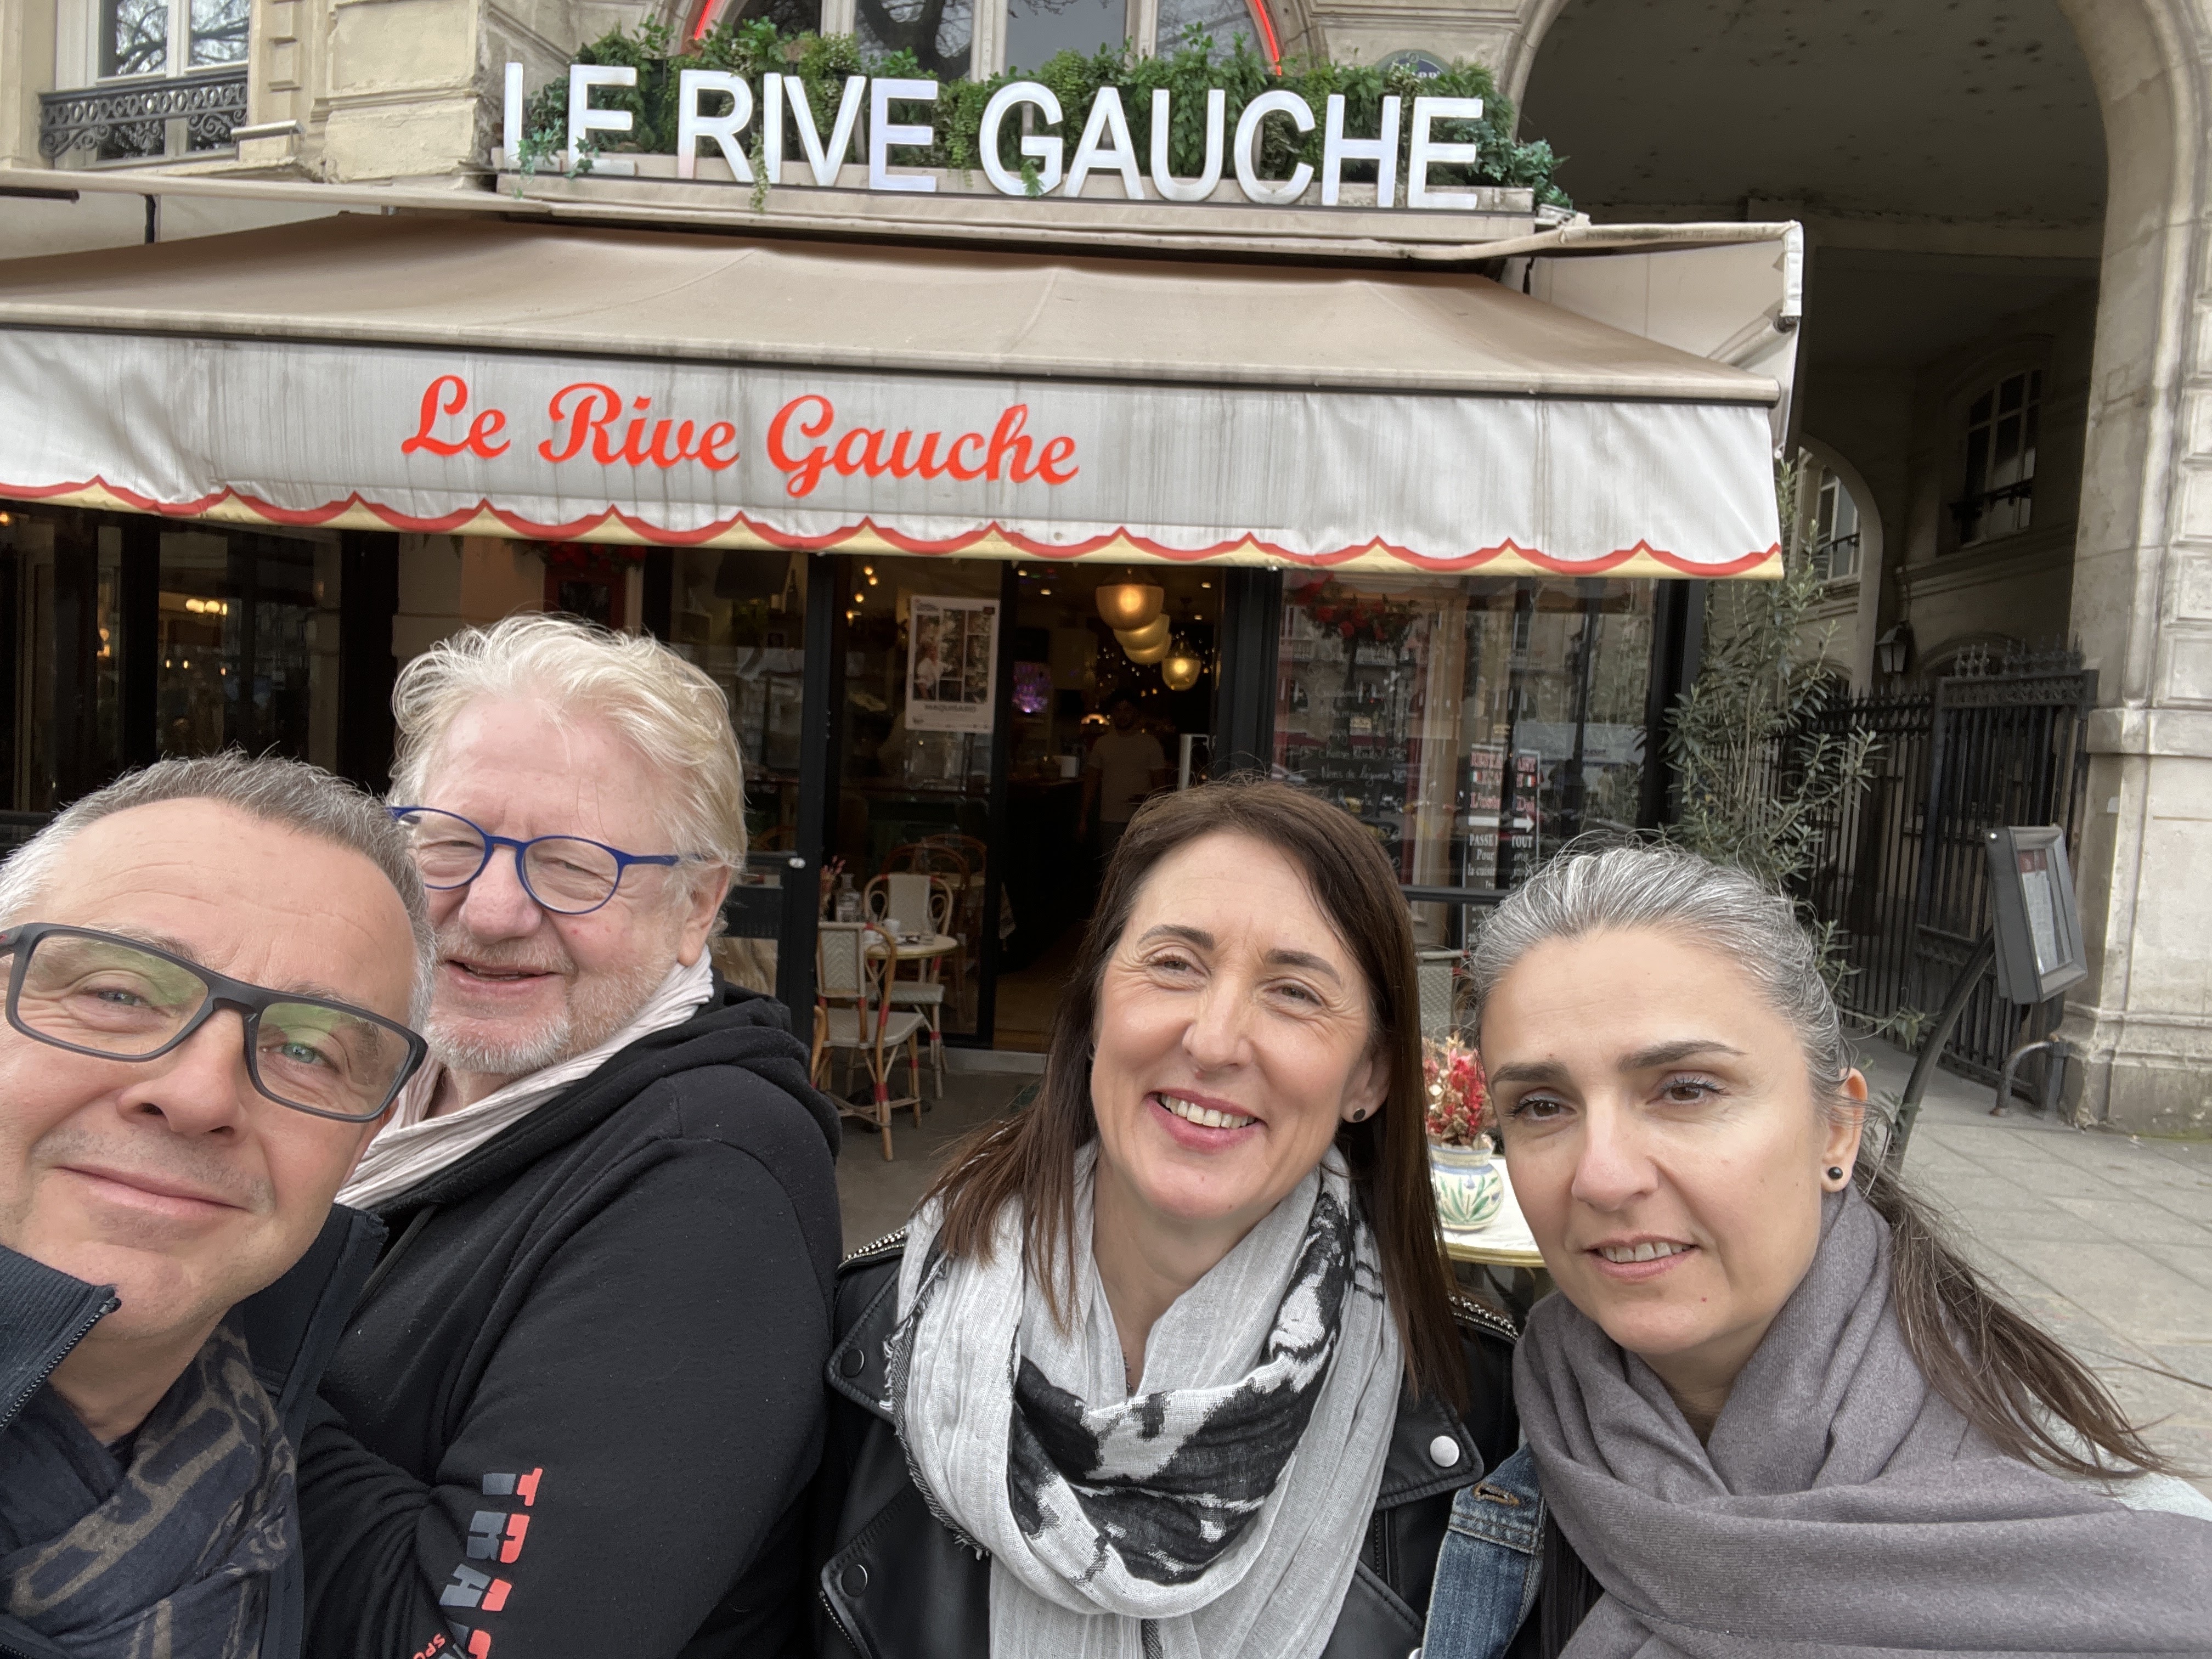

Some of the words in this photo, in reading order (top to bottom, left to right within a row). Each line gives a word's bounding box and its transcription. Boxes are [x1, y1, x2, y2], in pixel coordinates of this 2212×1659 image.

[504, 62, 637, 177] LE
[678, 69, 939, 192] RIVE
[979, 81, 1483, 210] GAUCHE
[401, 375, 511, 459] Le
[538, 382, 740, 471] Rive
[766, 394, 1081, 498] Gauche
